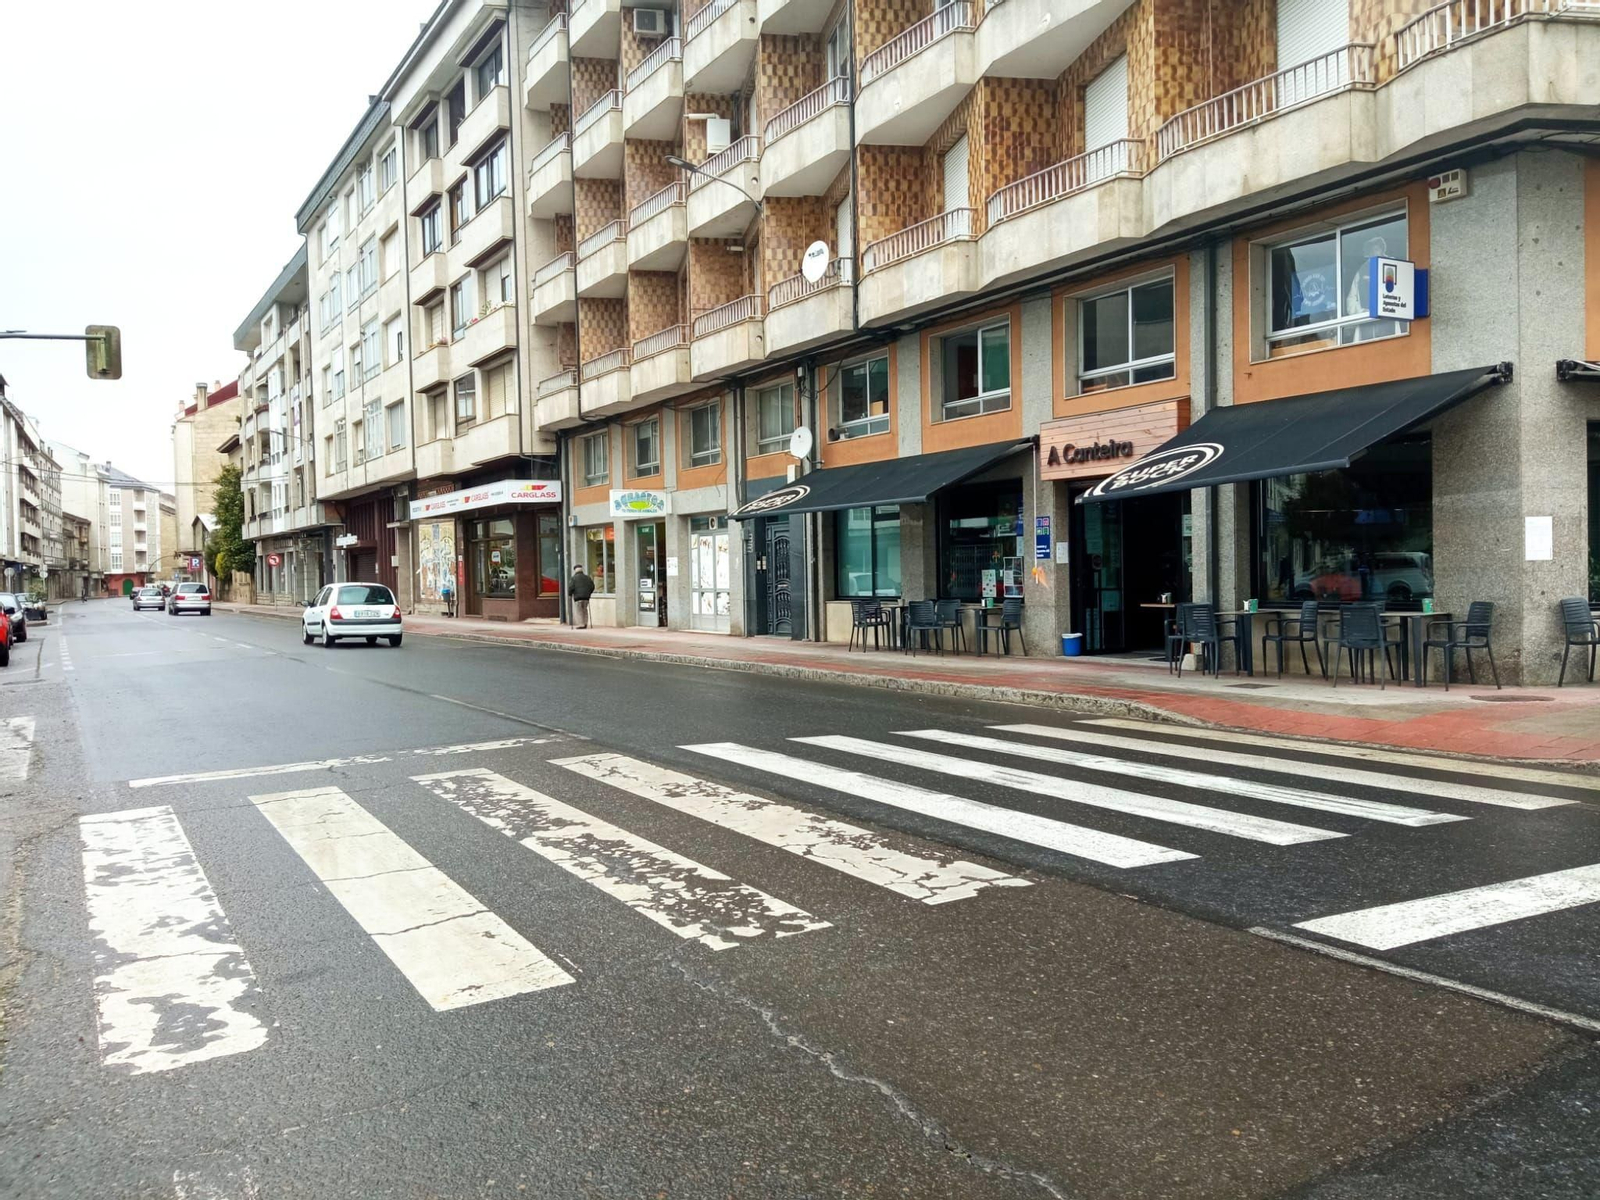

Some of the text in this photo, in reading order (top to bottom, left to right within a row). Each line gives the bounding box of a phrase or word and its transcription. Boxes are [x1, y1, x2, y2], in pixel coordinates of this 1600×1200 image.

[1047, 439, 1133, 467] A Canteira
[1115, 454, 1199, 481] SUPER
[511, 491, 557, 499] CARGLASS
